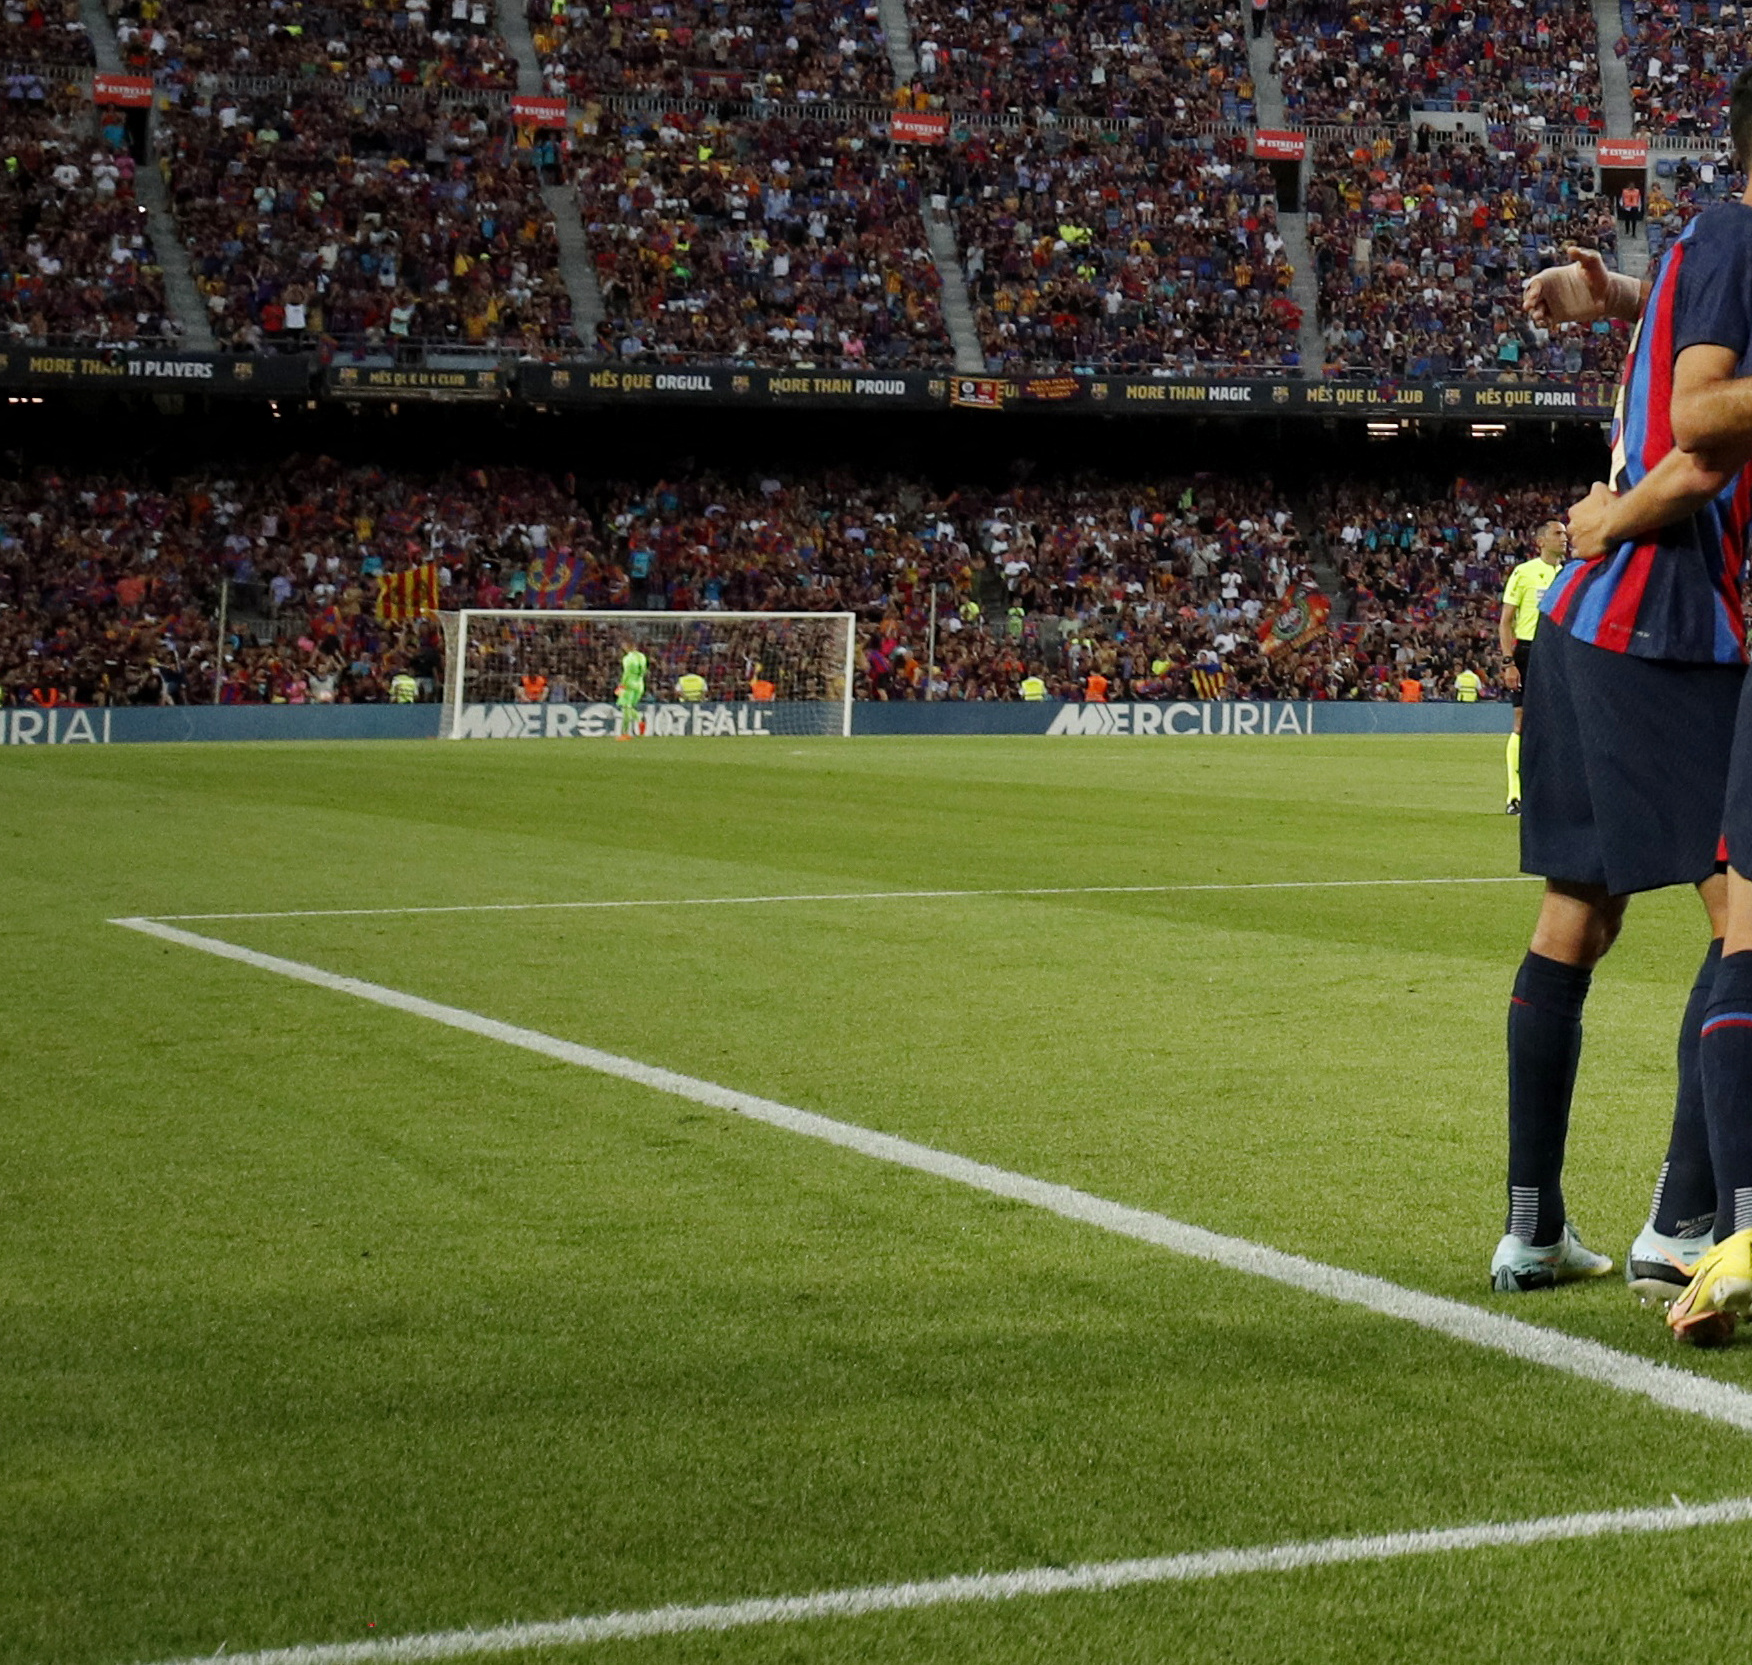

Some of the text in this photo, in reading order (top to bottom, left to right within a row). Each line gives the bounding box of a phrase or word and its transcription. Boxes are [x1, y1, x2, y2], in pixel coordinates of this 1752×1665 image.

[29, 357, 75, 375] MORE
[144, 360, 213, 378] PLAYERS
[439, 373, 466, 386] CLUB
[589, 370, 712, 392] MÉS QUE ORGULL
[769, 378, 905, 395] MORE THAN PROUD
[1126, 385, 1252, 402] MORE THAN MAGIC
[1307, 386, 1333, 403] MÉS
[1336, 388, 1364, 405] QUE
[1475, 388, 1502, 405] MÉS
[1504, 390, 1532, 407] QUE
